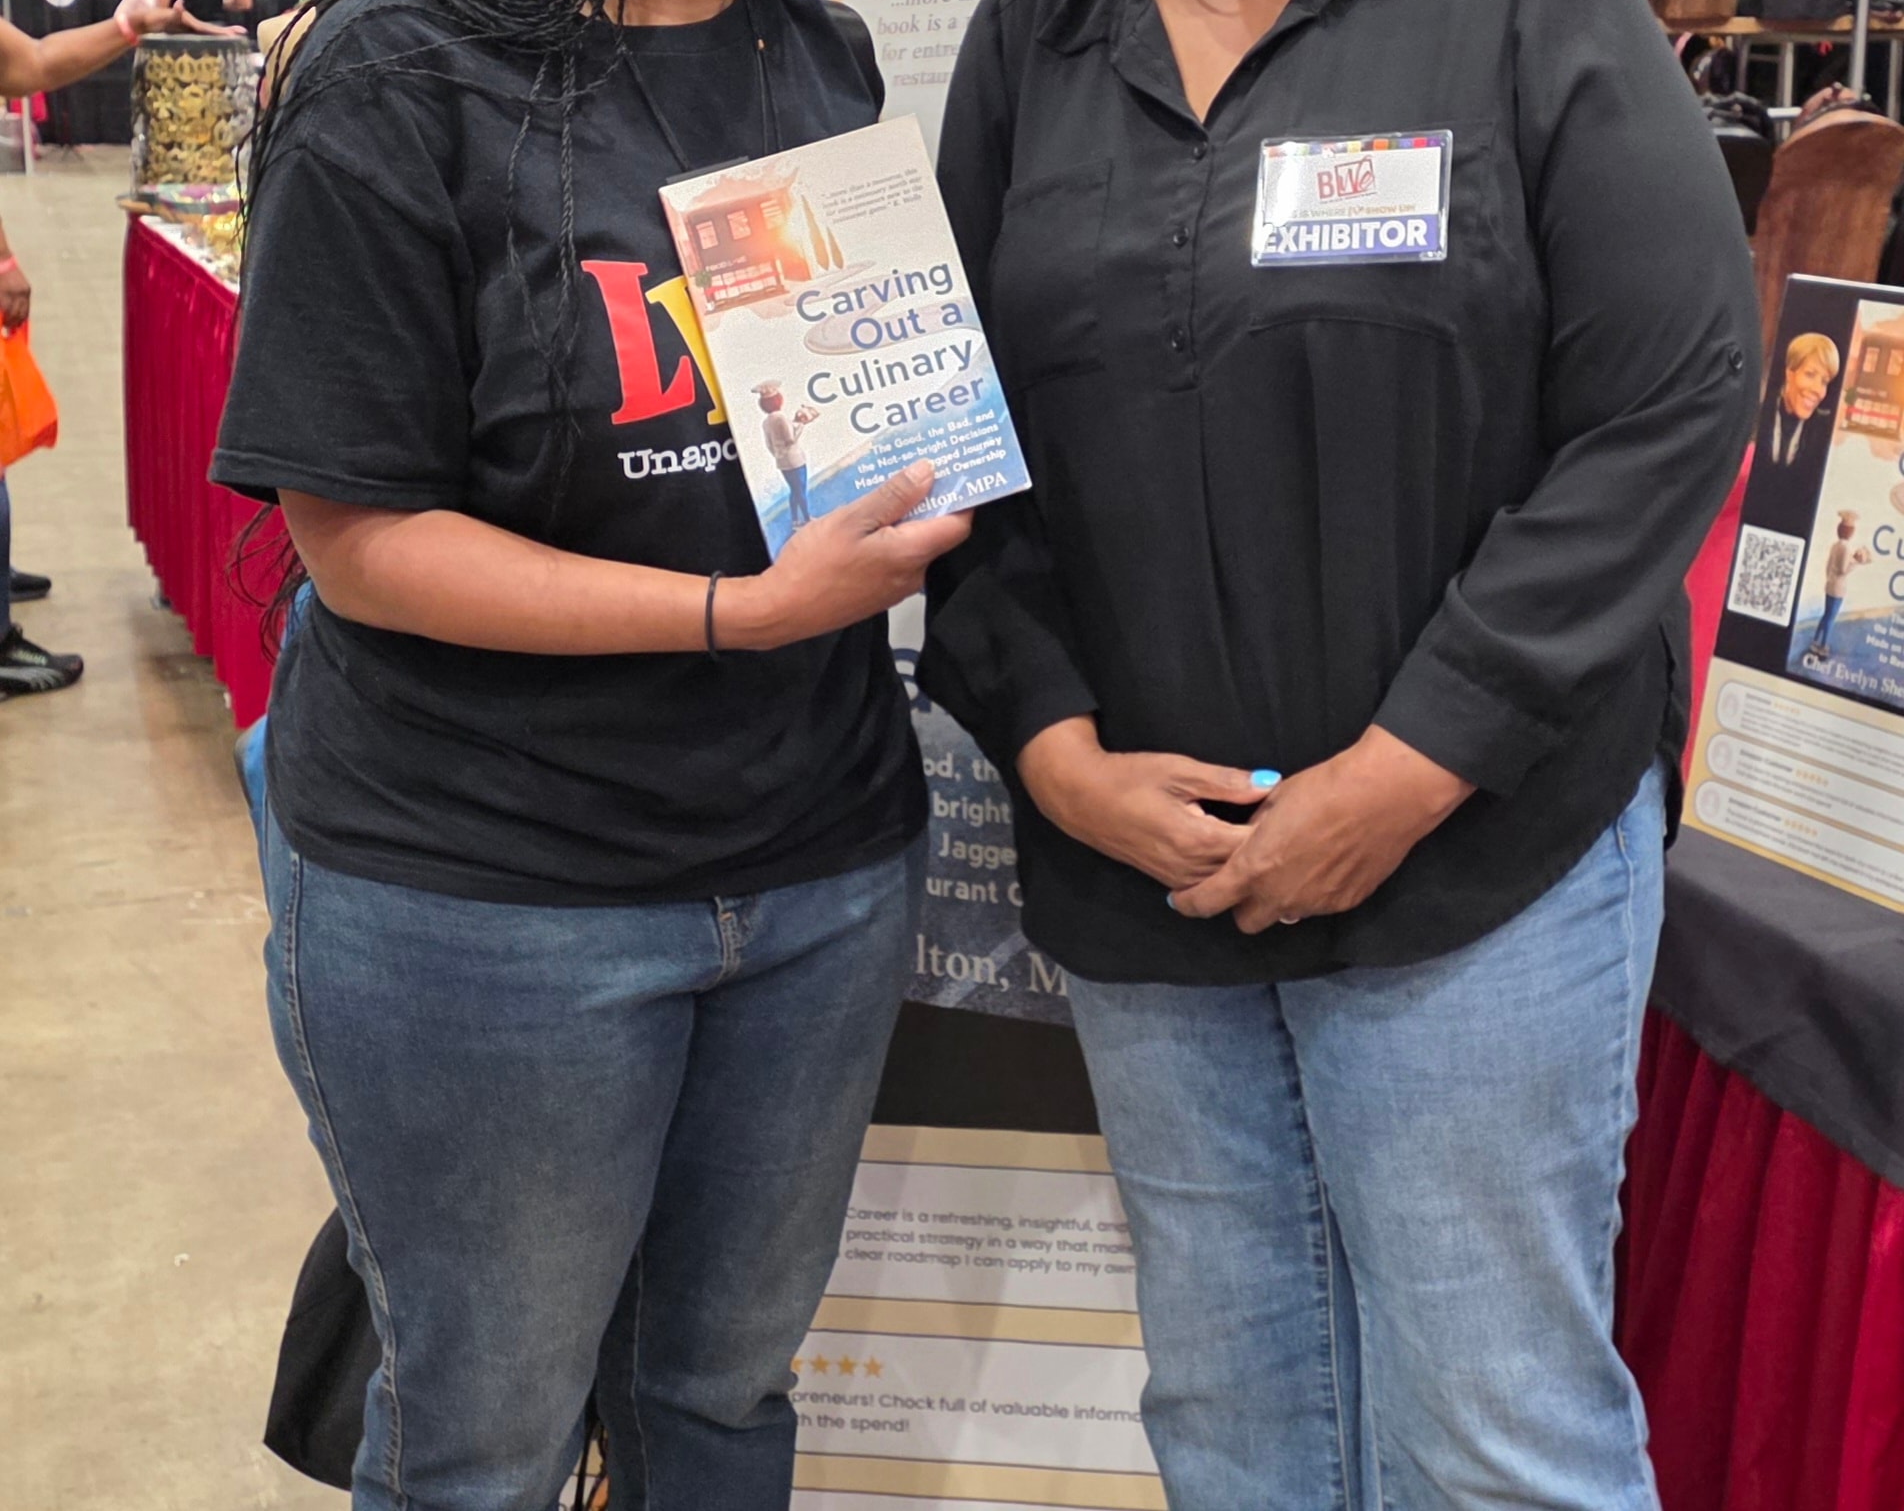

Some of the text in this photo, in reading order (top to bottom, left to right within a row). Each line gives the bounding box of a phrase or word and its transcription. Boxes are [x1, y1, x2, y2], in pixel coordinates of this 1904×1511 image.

[877, 14, 920, 35] book
[928, 14, 941, 31] is
[948, 17, 957, 29] a
[882, 42, 960, 62] for entre
[893, 72, 952, 87] restau
[1265, 219, 1427, 254] EXHIBITOR
[796, 264, 952, 322] Carving
[851, 302, 963, 349] Out a
[807, 340, 971, 403] Culinary
[851, 378, 983, 433] Career
[858, 462, 875, 474] the
[877, 441, 947, 468] Not-so-bright
[951, 424, 998, 445] Decisions
[872, 443, 891, 455] The
[928, 427, 944, 438] the
[976, 409, 995, 423] and
[617, 439, 738, 479] Unapo
[855, 474, 885, 489] Made
[962, 436, 1002, 455] Journey
[953, 450, 1006, 472] Ownership
[966, 472, 1008, 496] MPA
[1803, 652, 1832, 675] Chef
[1835, 662, 1878, 690] Evelyn
[922, 752, 1000, 783] od, th
[933, 790, 1011, 827] bright
[938, 832, 1017, 869] Jagge
[926, 877, 999, 904] urant
[915, 934, 1010, 992] lton,
[846, 1207, 898, 1221] Career
[902, 1209, 914, 1222] is
[918, 1212, 929, 1223] a
[846, 1229, 914, 1244] practical
[918, 1233, 982, 1251] strategy
[987, 1236, 1001, 1248] in
[1005, 1239, 1016, 1249] a
[1021, 1239, 1053, 1254] way
[1056, 1239, 1089, 1253] that
[845, 1247, 884, 1261] clear
[887, 1251, 962, 1269] roadmap
[973, 1256, 1004, 1268] can
[1007, 1258, 1052, 1274] apply
[1056, 1259, 1072, 1272] to
[1076, 1262, 1101, 1277] my
[791, 1390, 1143, 1423] preneurs! Chock full of valuable informa
[817, 1414, 845, 1428] the
[851, 1417, 910, 1433] spend!
